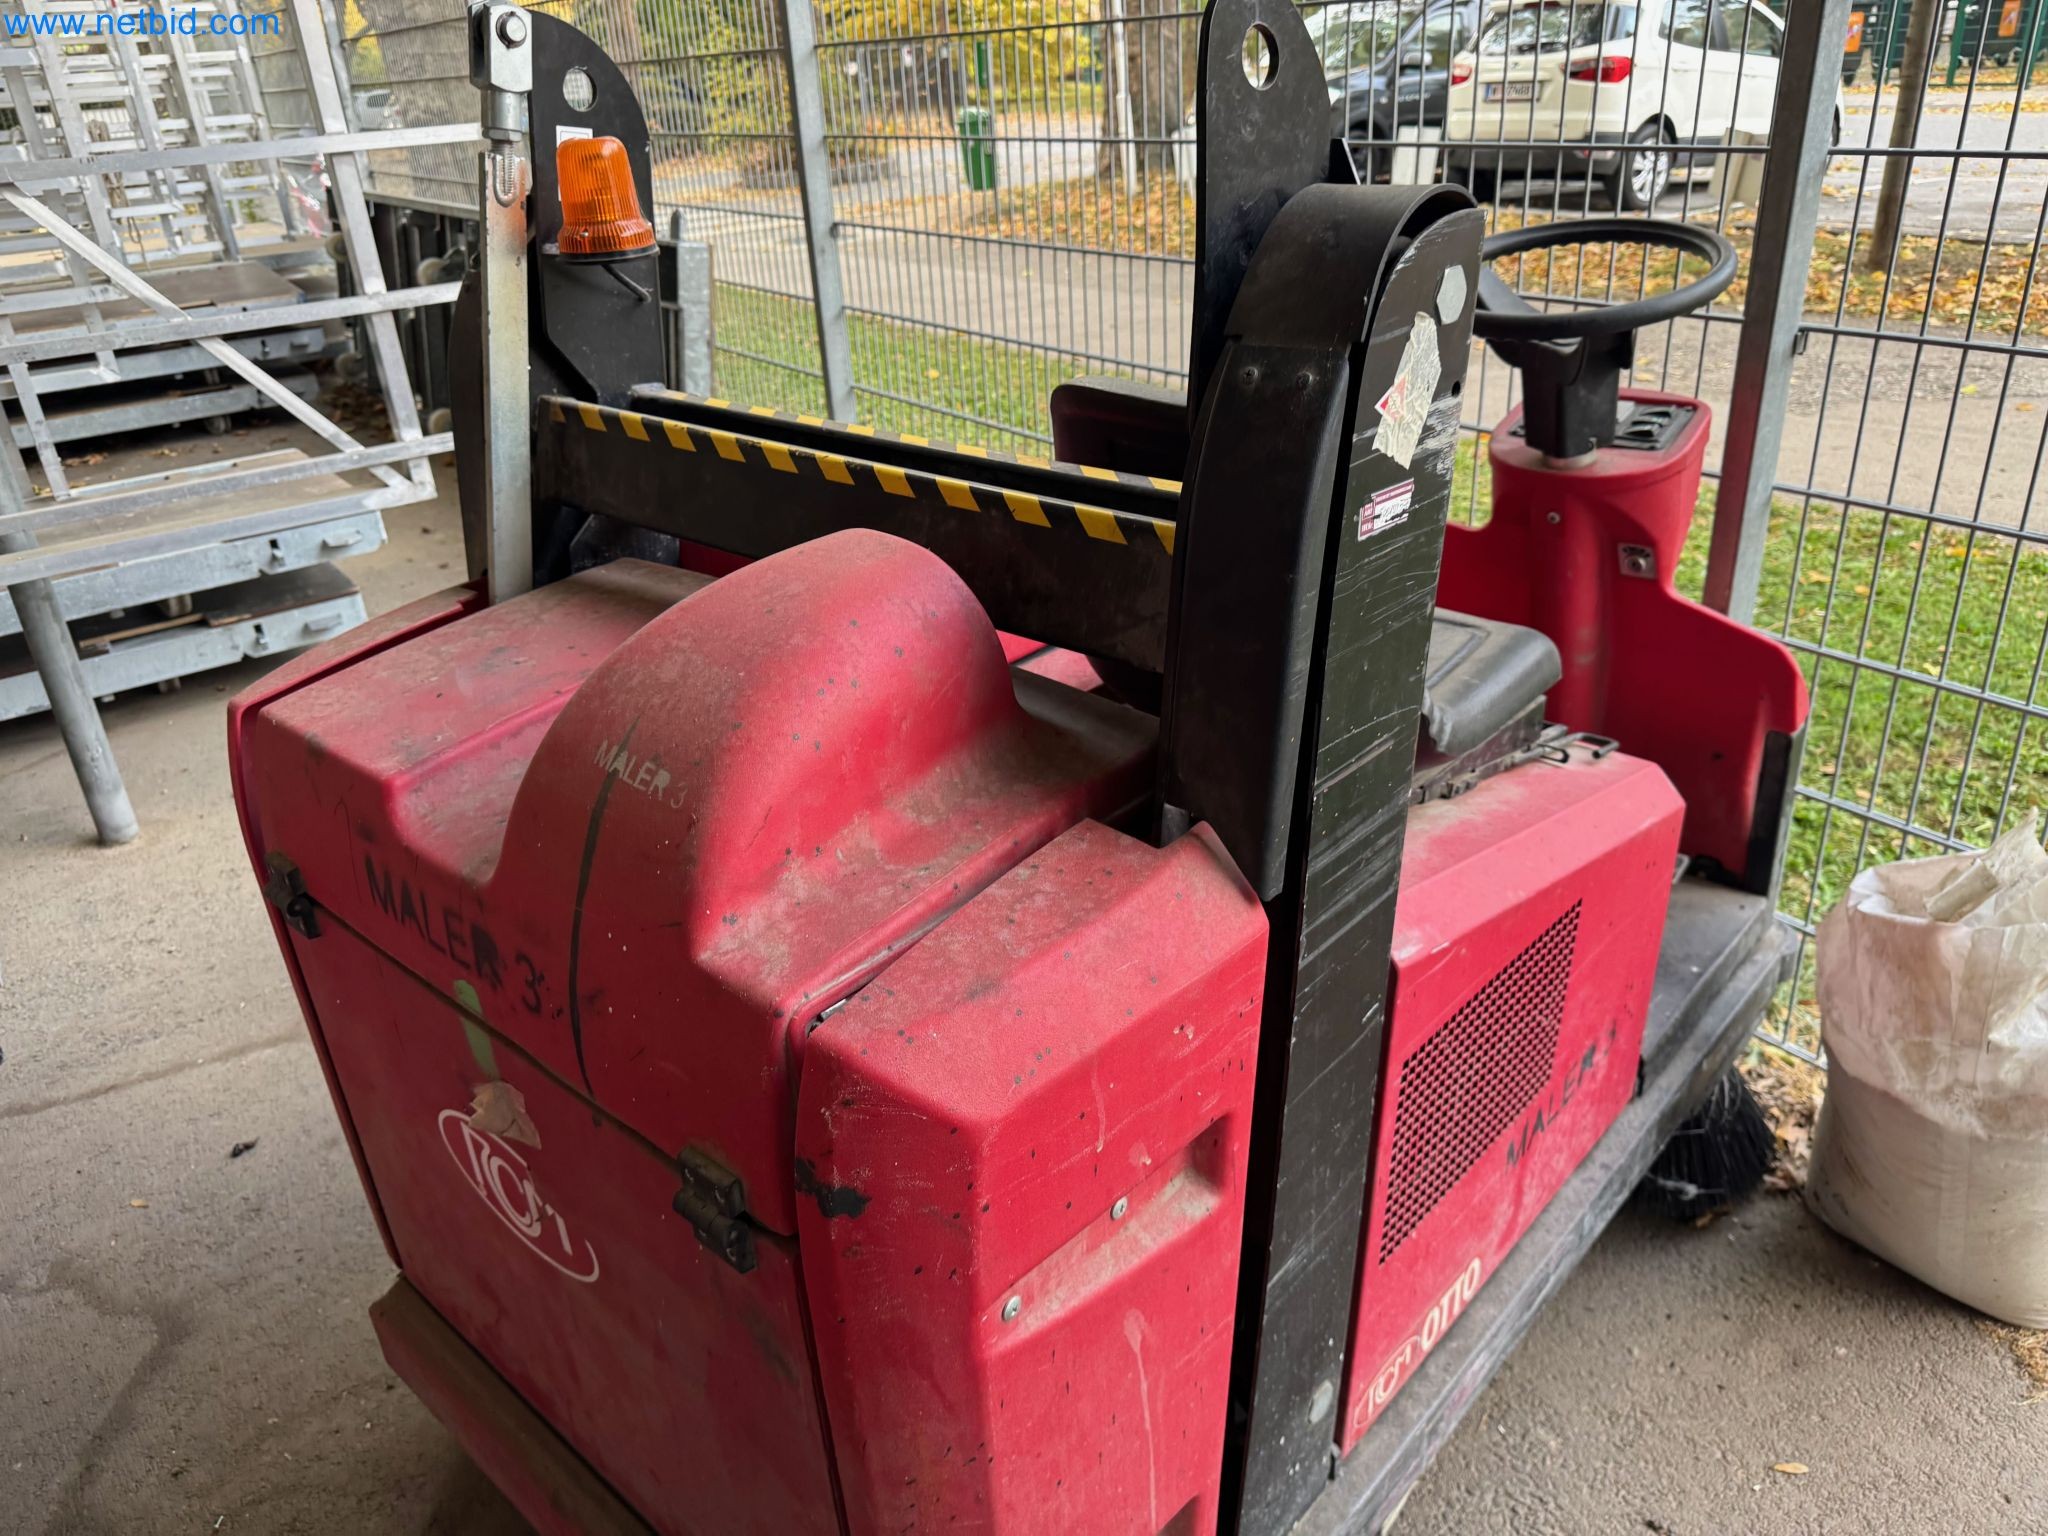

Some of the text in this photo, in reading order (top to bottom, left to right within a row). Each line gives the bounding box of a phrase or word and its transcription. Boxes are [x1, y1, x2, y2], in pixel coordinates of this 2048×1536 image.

[593, 738, 672, 801] MALER
[364, 853, 546, 1016] MALER 3
[1420, 1256, 1482, 1352] OTTO
